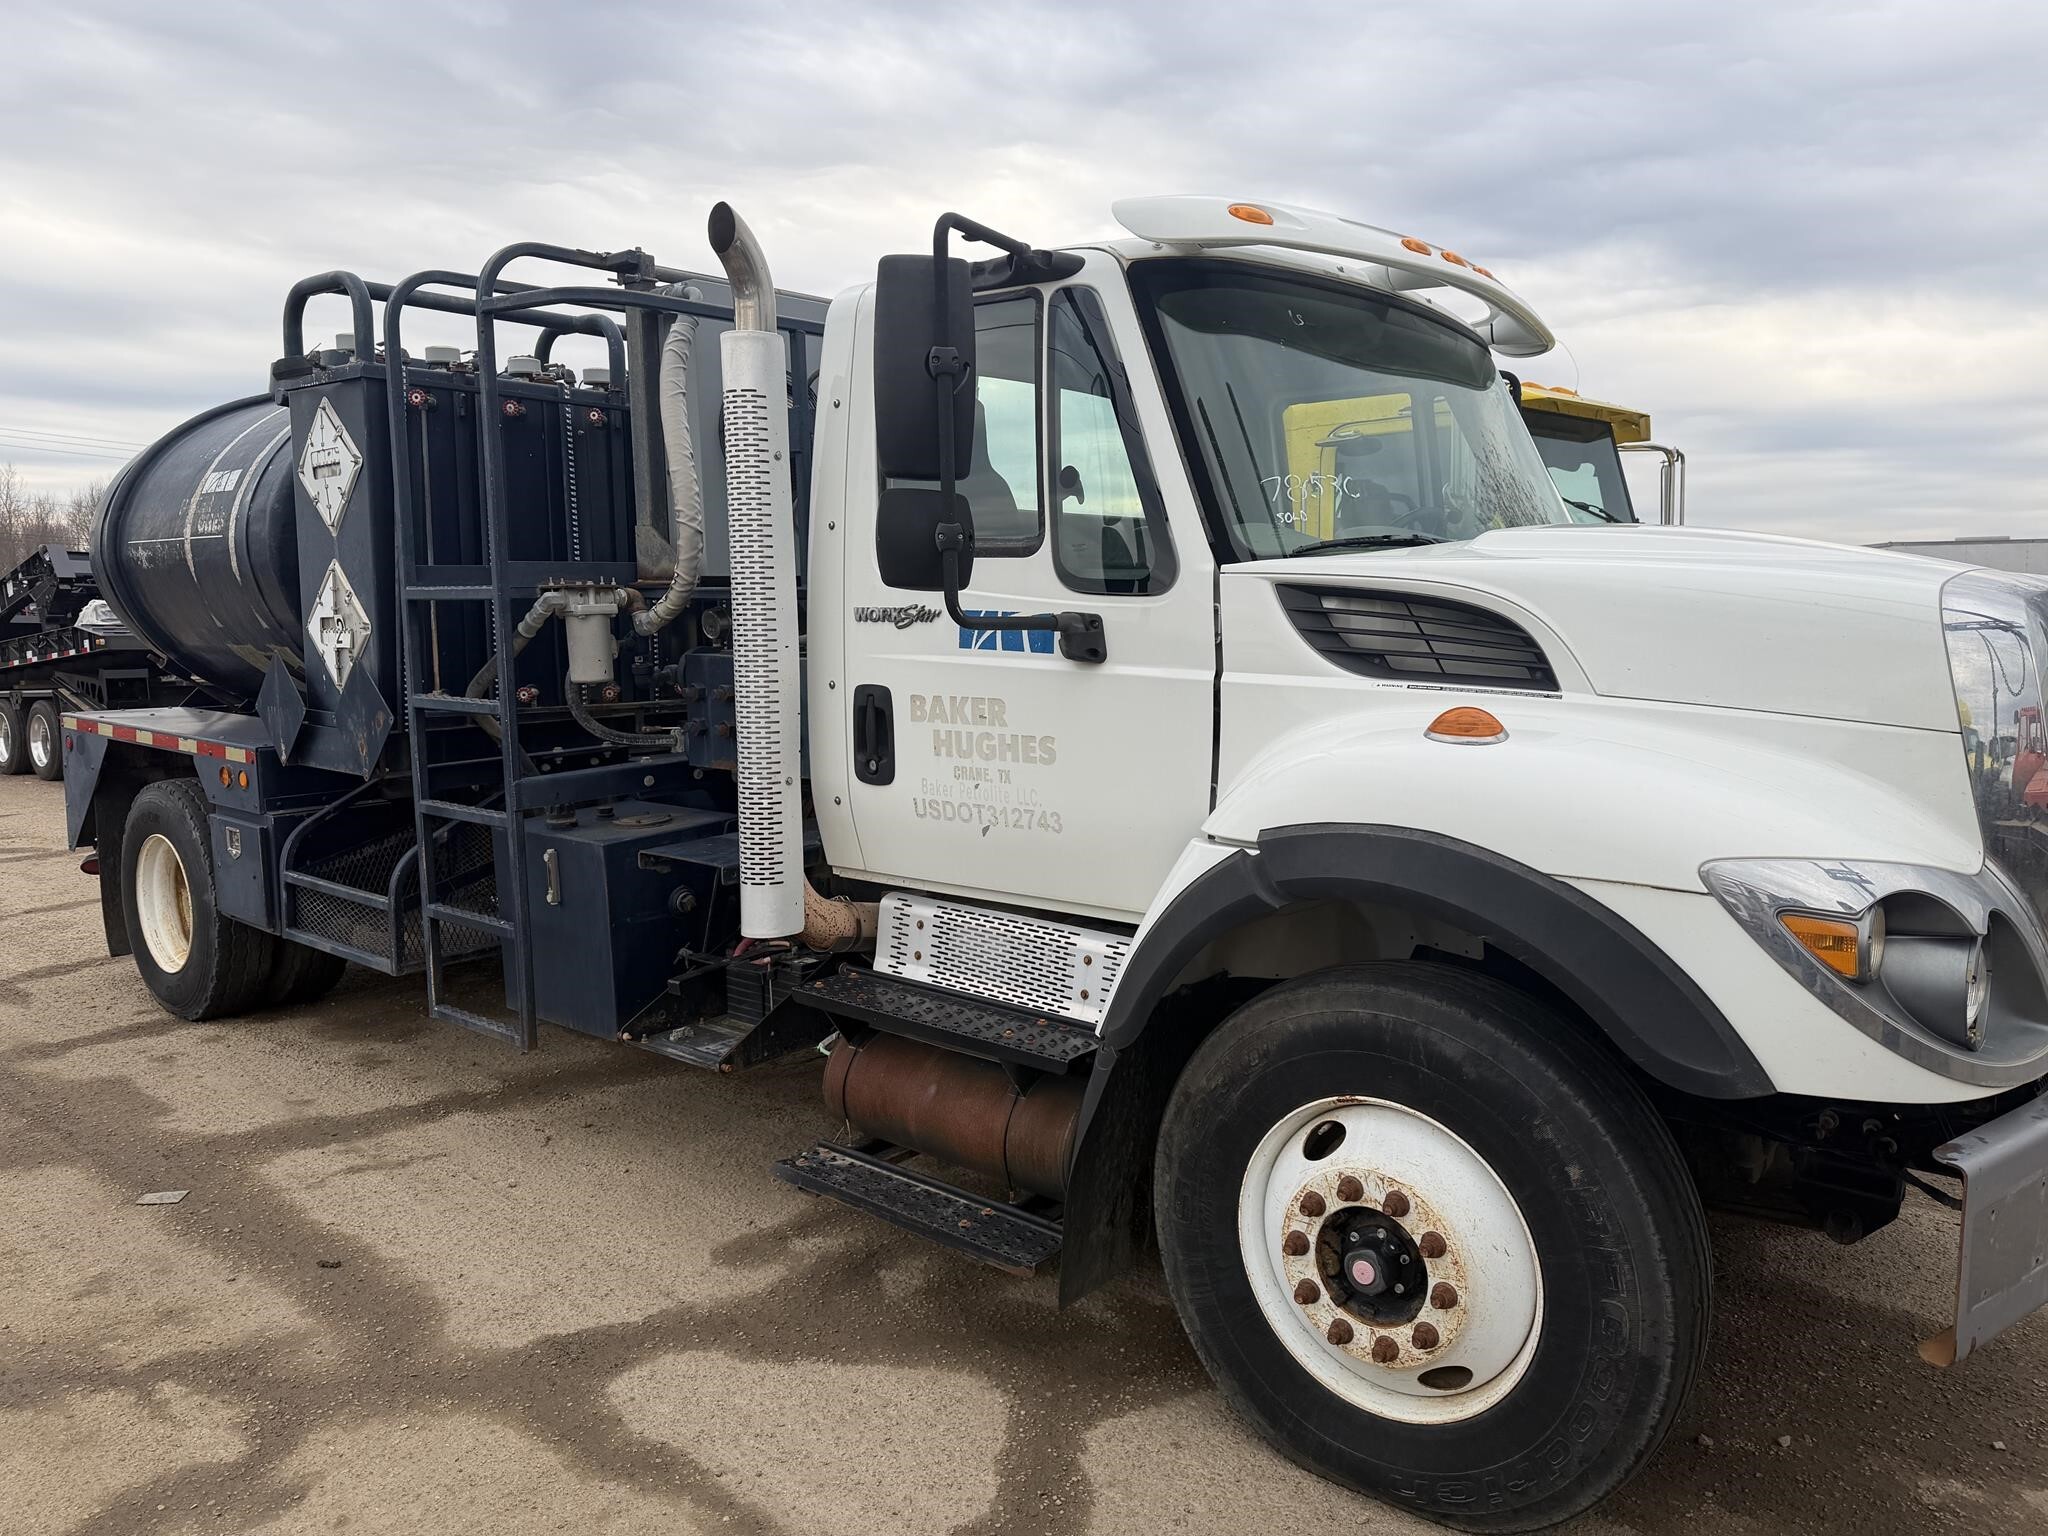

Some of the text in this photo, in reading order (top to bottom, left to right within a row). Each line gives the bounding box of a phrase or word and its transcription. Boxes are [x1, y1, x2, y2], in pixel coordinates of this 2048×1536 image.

[1276, 510, 1307, 524] SOLD
[909, 694, 1009, 728] BAKER
[932, 729, 1057, 766] HUGHES
[921, 777, 953, 798] Baker
[959, 781, 1011, 805] Petrolite
[997, 768, 1012, 785] TX
[912, 797, 1064, 836] USDOT312743
